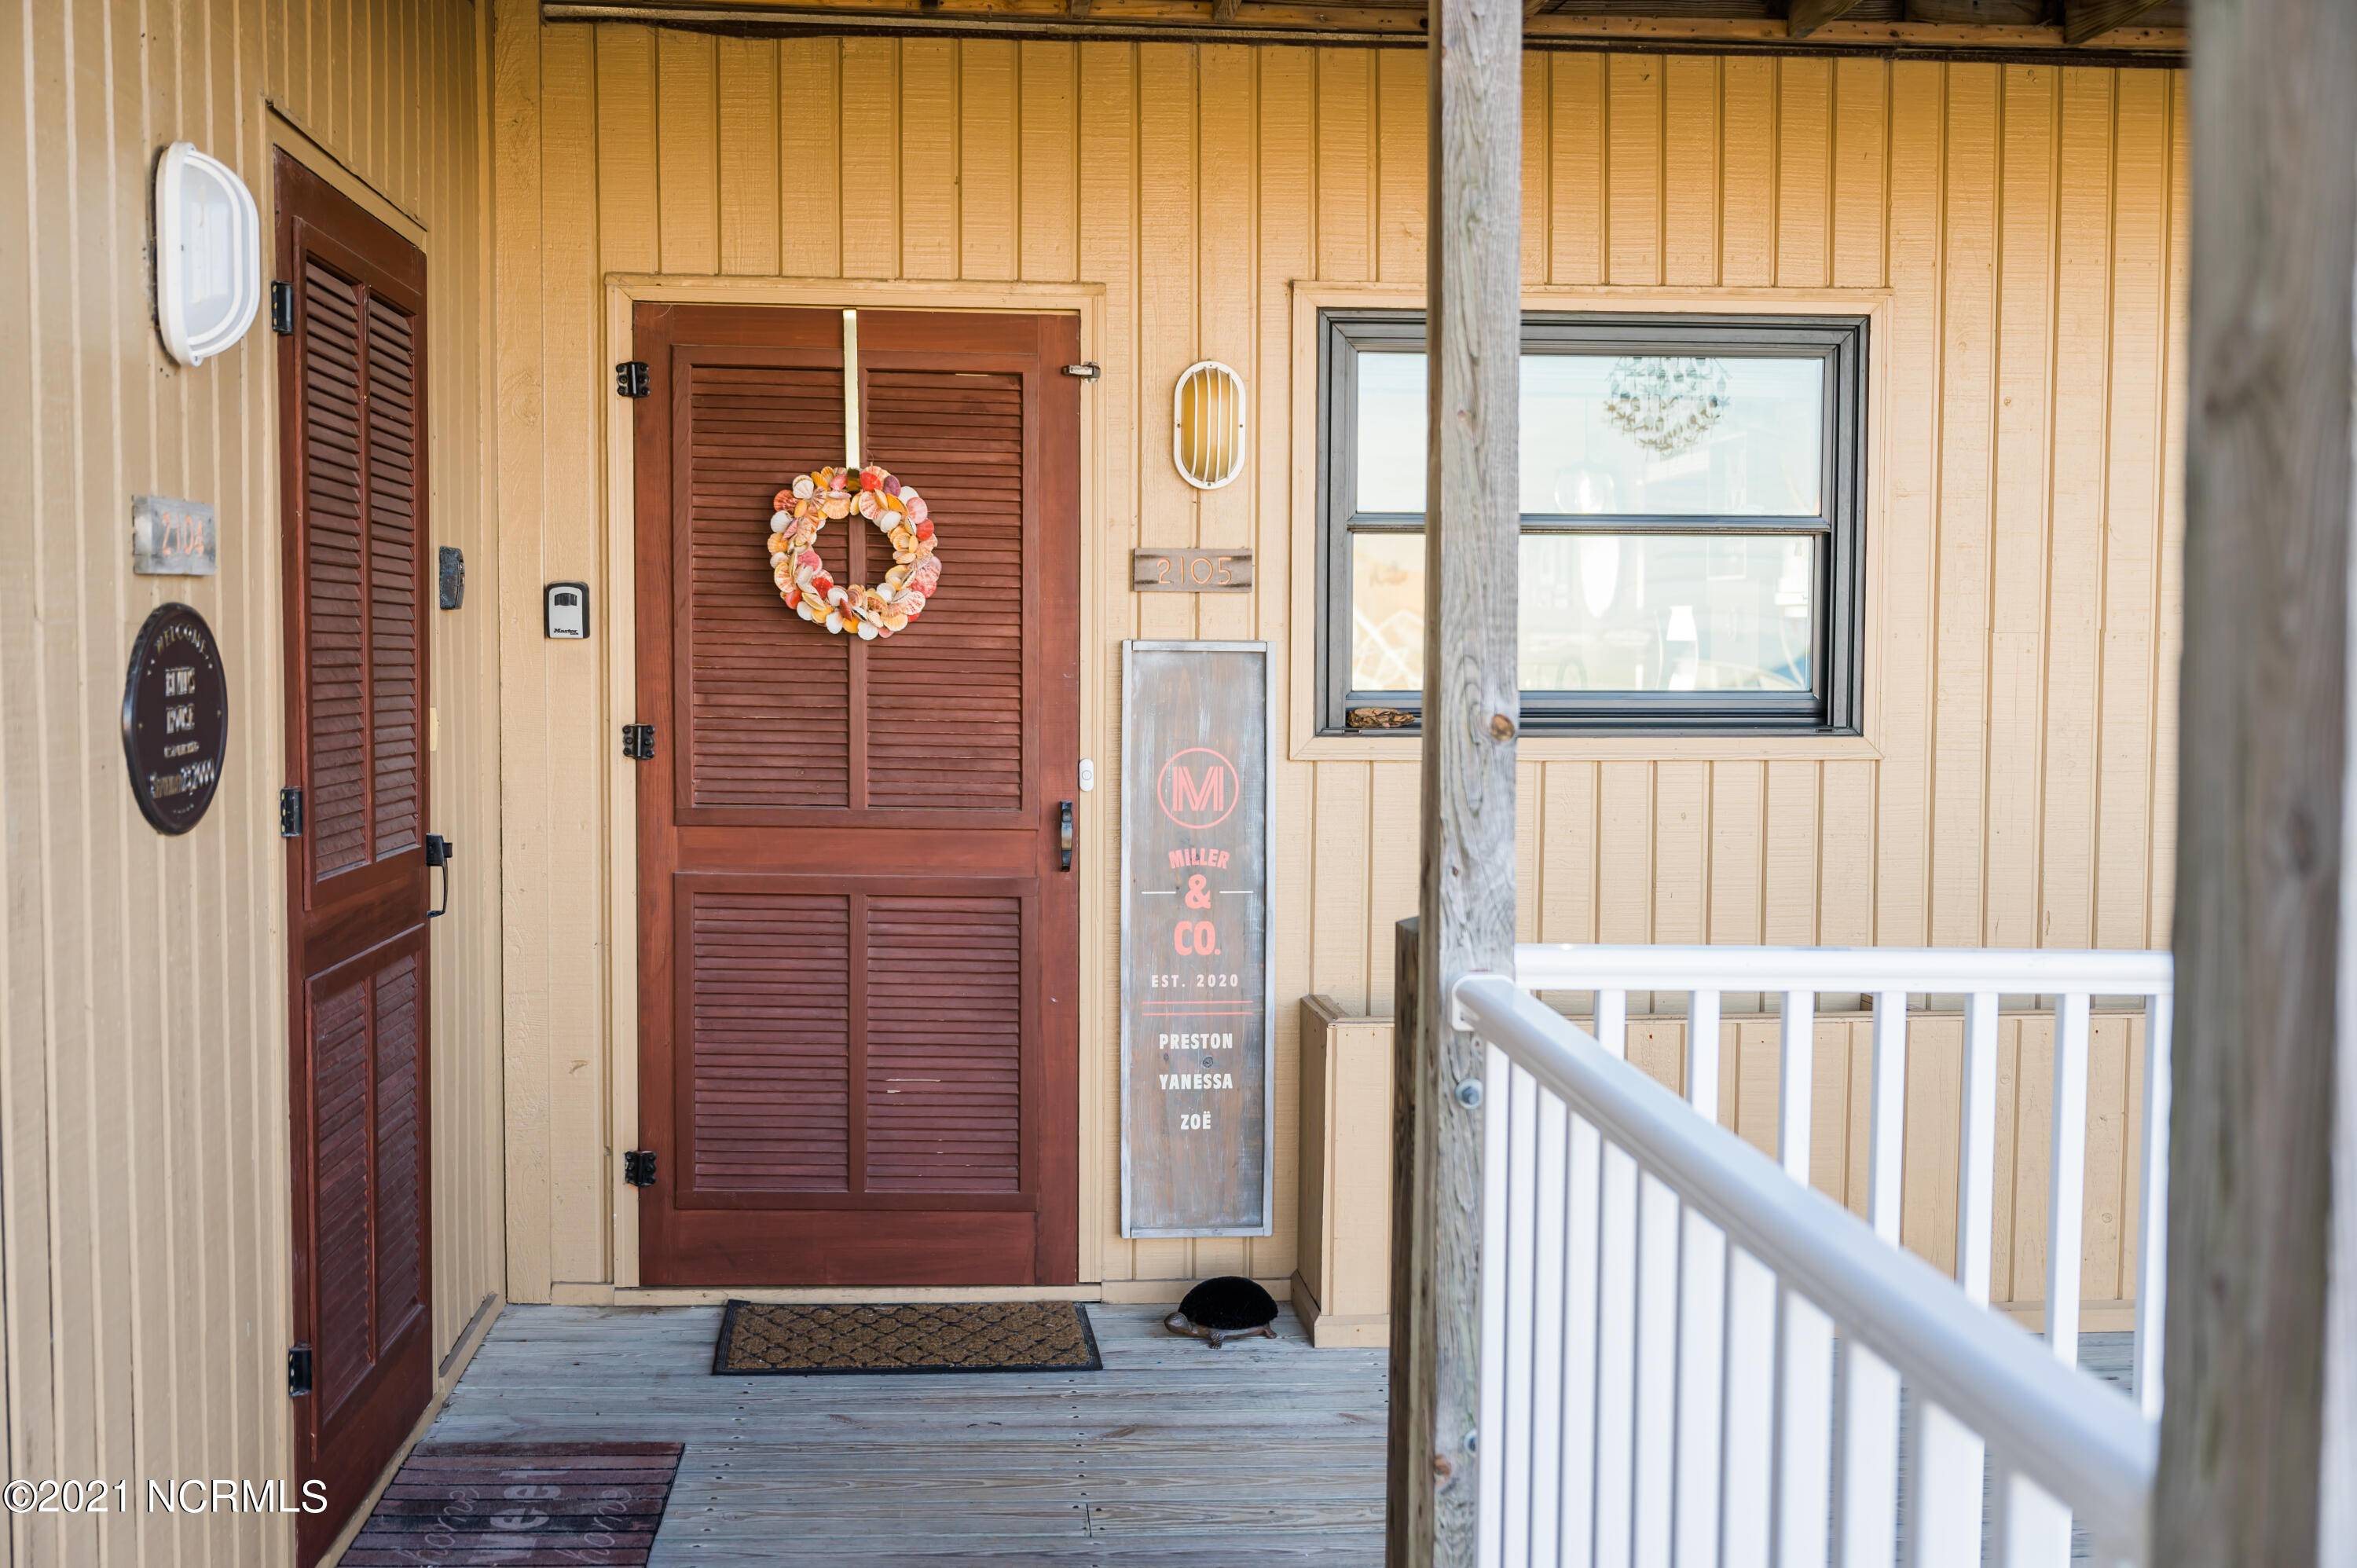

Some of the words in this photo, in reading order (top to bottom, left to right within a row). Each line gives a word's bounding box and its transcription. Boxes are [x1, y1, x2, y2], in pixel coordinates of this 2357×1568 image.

[1157, 557, 1232, 584] 2105
[1172, 766, 1223, 811] M
[1168, 847, 1230, 870] MILLER
[1185, 874, 1211, 909] &
[1174, 921, 1221, 956] CO.
[1151, 975, 1186, 987] EST.
[1197, 974, 1238, 987] 2020
[1159, 1033, 1233, 1050] PRESTON
[1180, 1111, 1211, 1130] ZOË
[467, 1466, 572, 1564] weet
